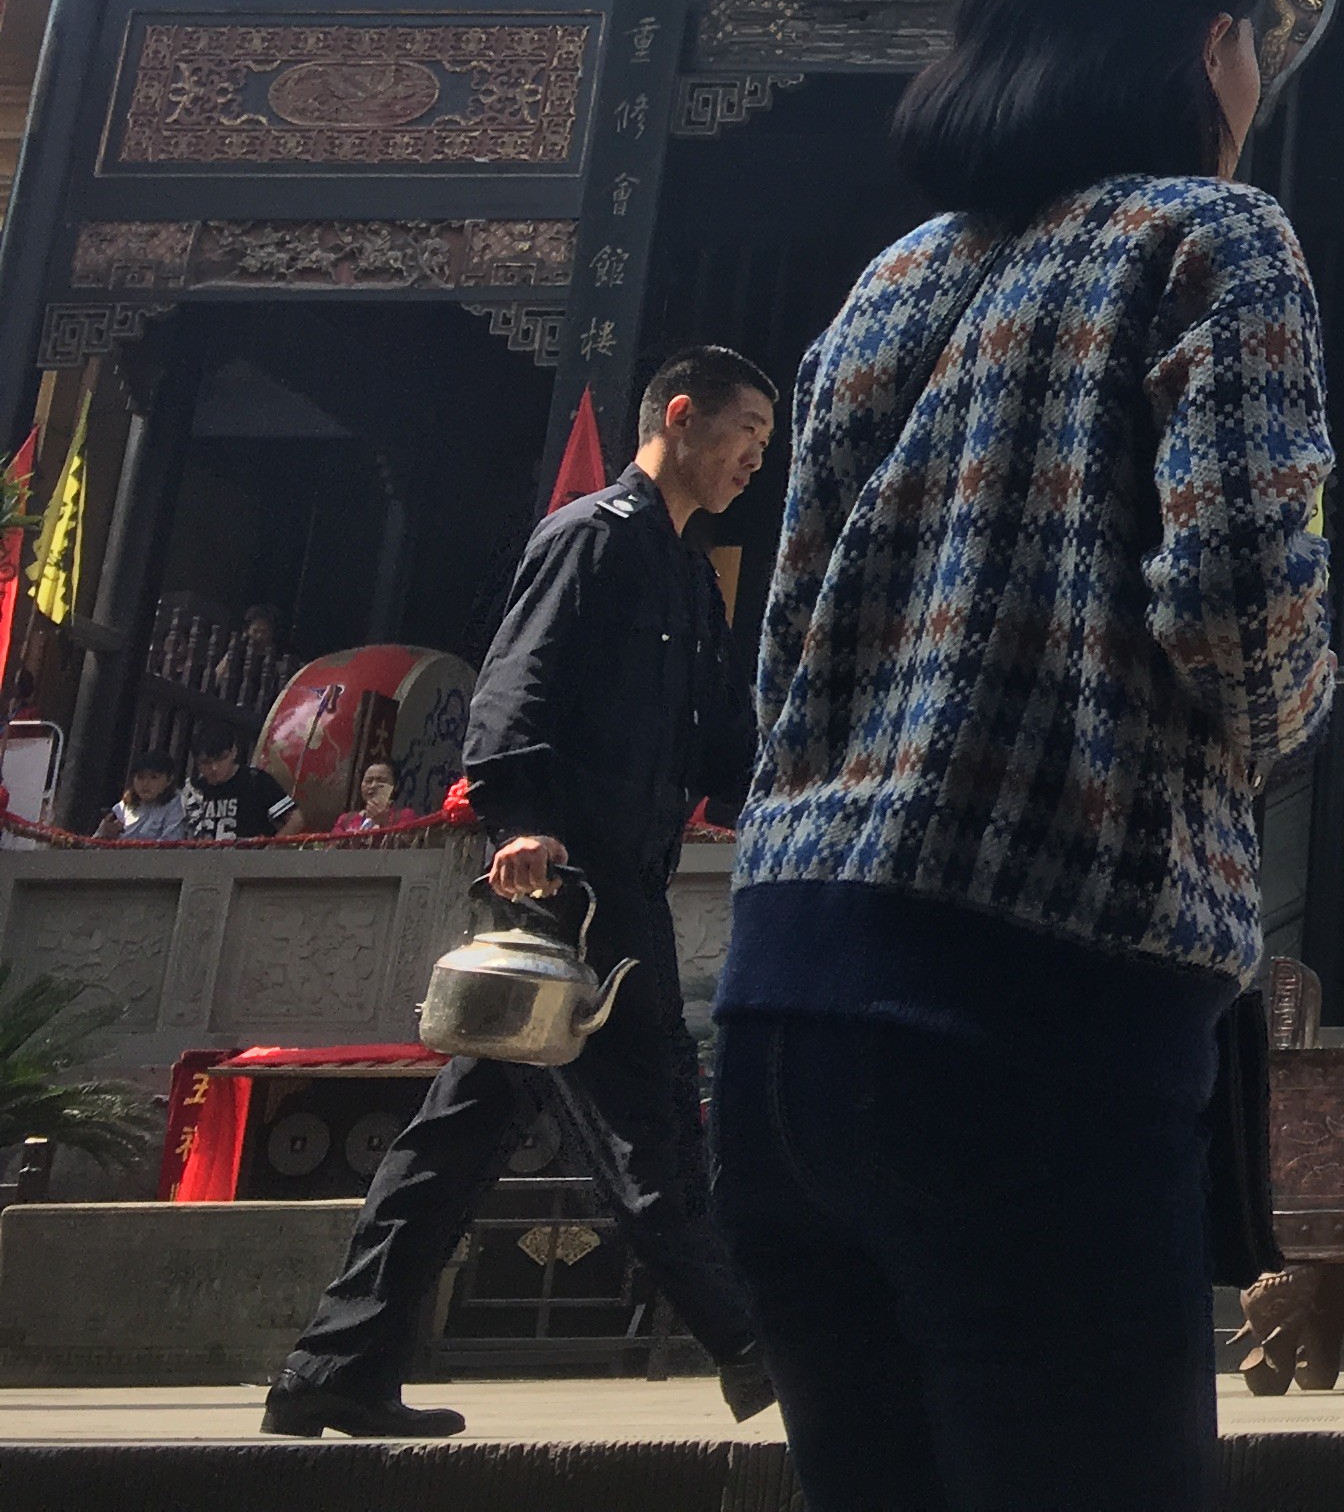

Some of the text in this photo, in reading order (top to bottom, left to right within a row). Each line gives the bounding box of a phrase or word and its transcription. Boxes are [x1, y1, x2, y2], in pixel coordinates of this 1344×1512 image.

[570, 17, 661, 420] 重修會館樓
